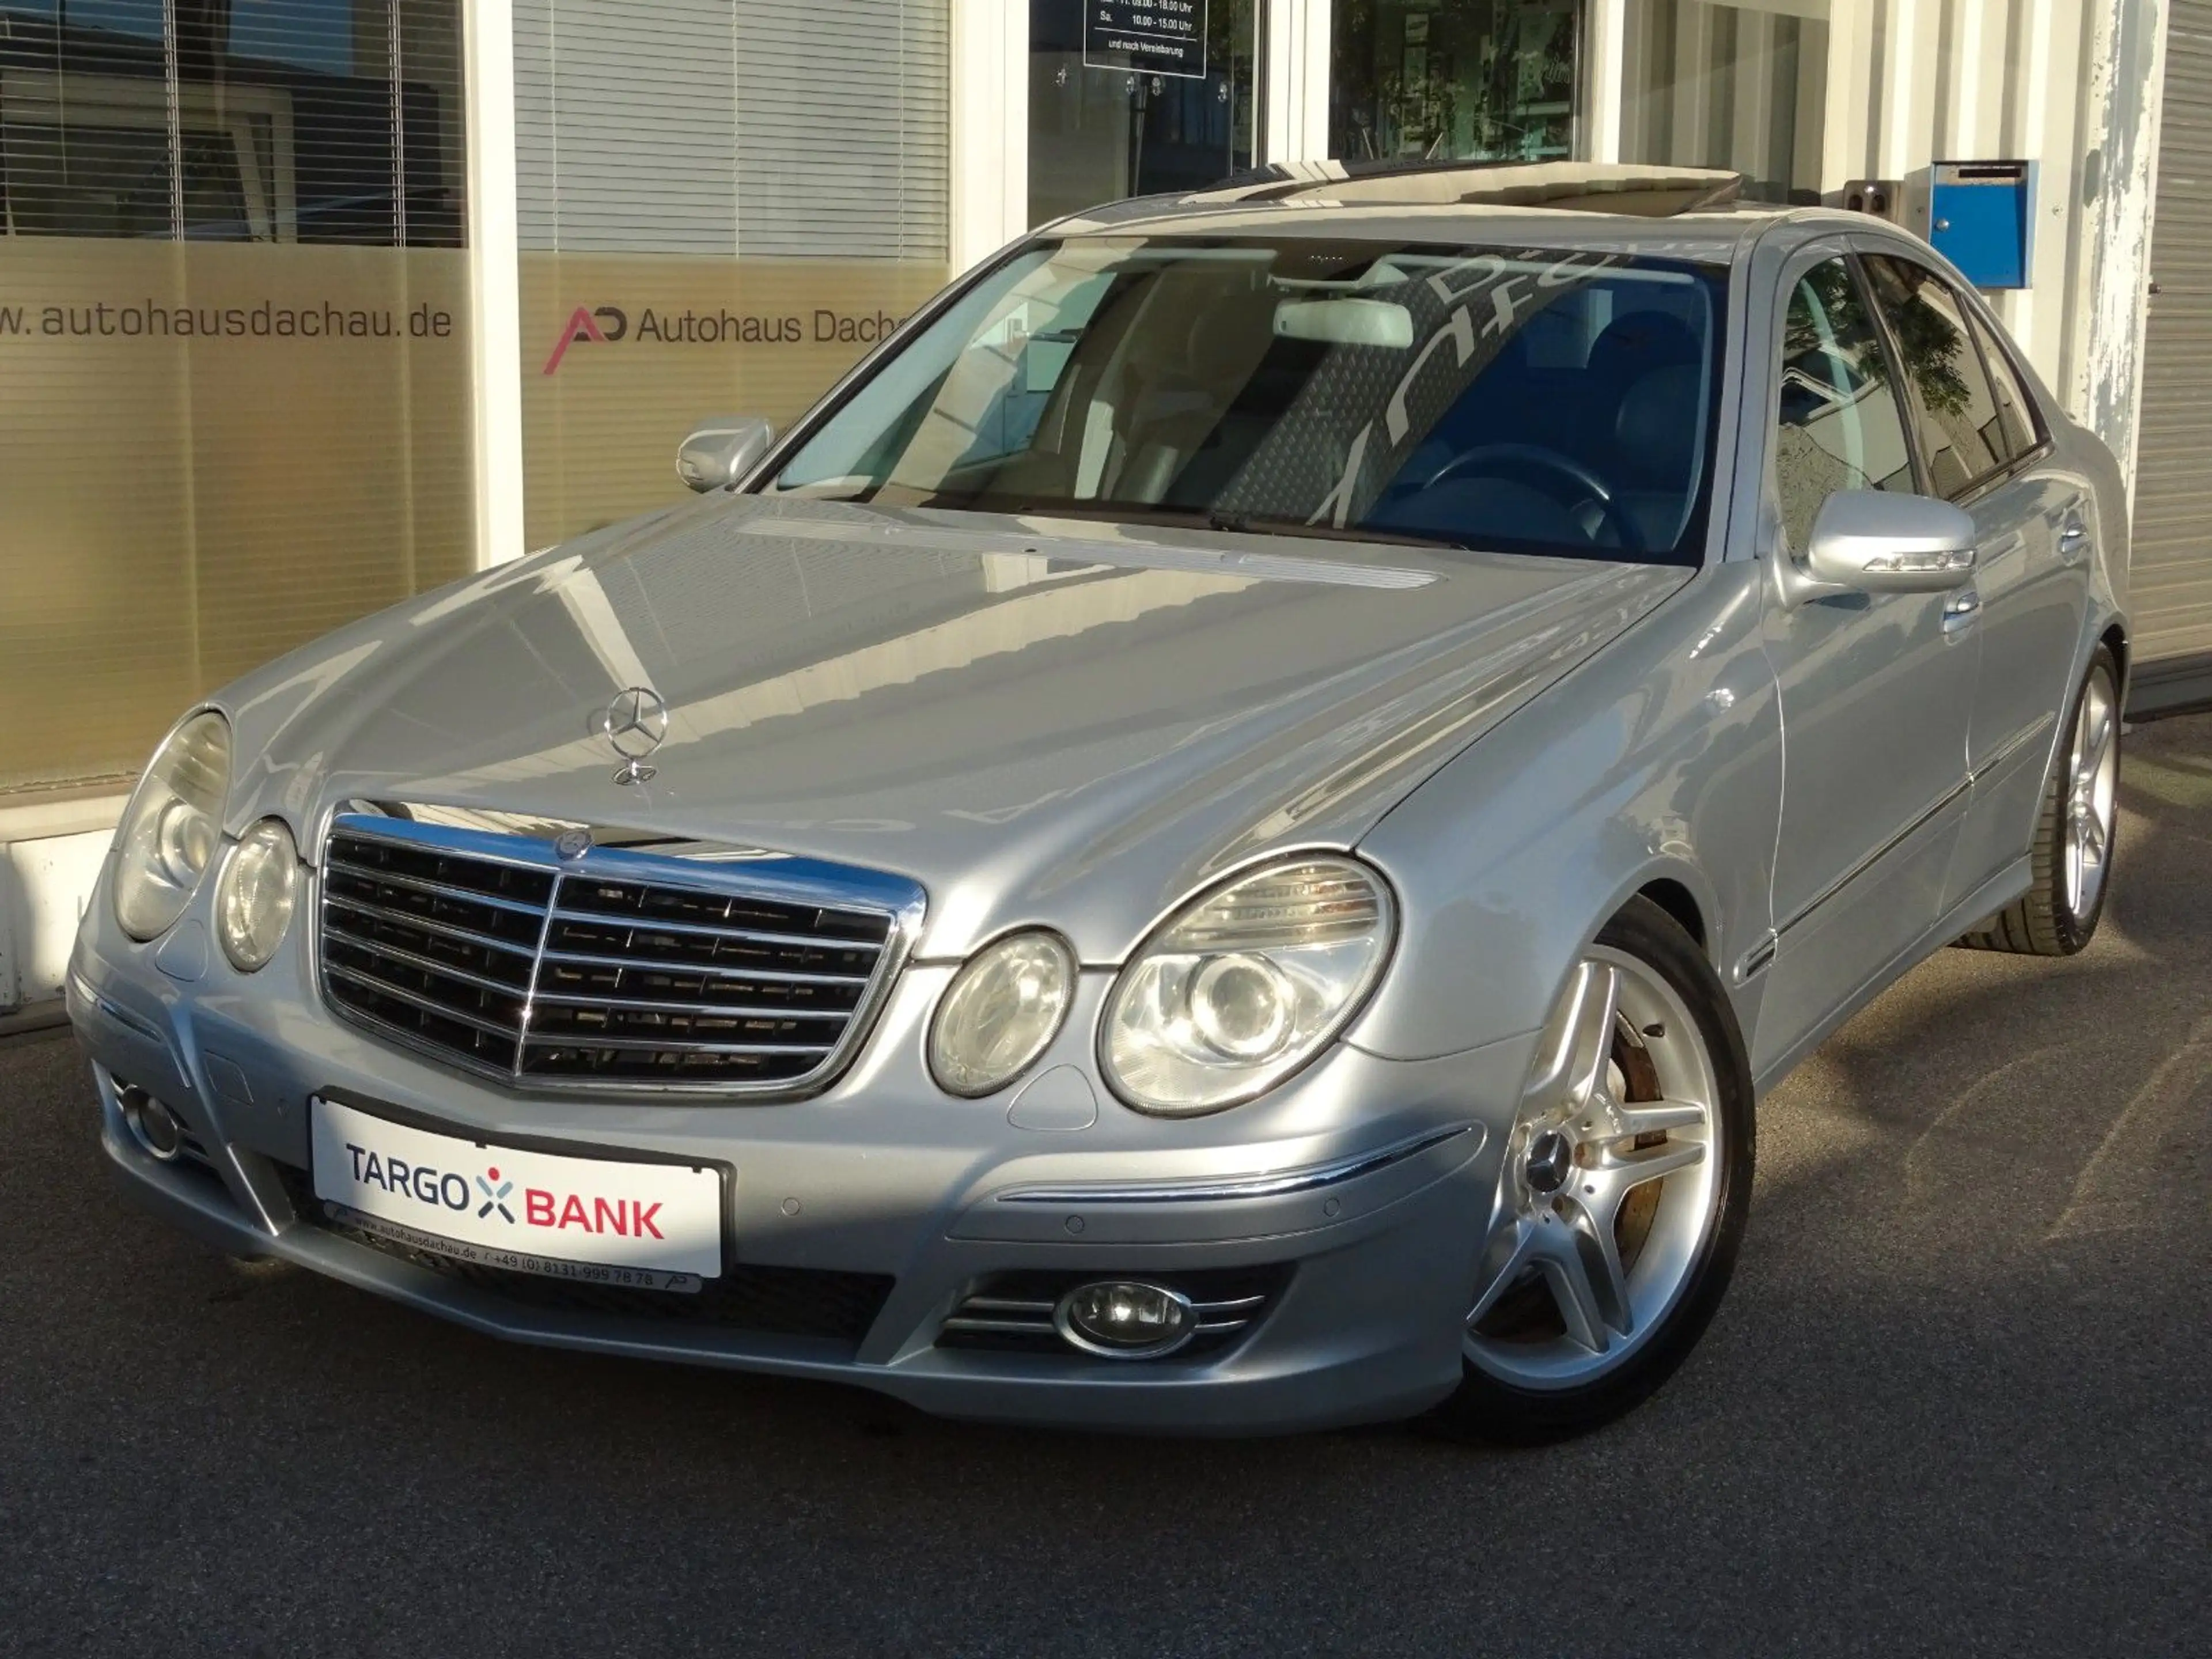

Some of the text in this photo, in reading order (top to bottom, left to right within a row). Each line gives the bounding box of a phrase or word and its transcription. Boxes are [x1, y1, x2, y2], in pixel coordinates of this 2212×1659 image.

[1159, 0, 1178, 11] 18.00
[1179, 2, 1193, 13] Uhr
[1100, 10, 1112, 22] Sa.
[1132, 15, 1152, 26] 10.00
[1159, 18, 1177, 29] 15.00
[1179, 20, 1192, 31] Uhr
[1108, 40, 1183, 58] und nach Vereinbarung
[636, 309, 802, 343] Autohaus
[815, 309, 910, 343] Dach
[346, 1143, 665, 1240] TARGO BANK
[355, 1217, 476, 1259] www.autohausdachau.de
[494, 1254, 517, 1267] +49
[522, 1260, 539, 1271] (0)
[615, 1270, 631, 1284] 78
[635, 1271, 653, 1286] 78
